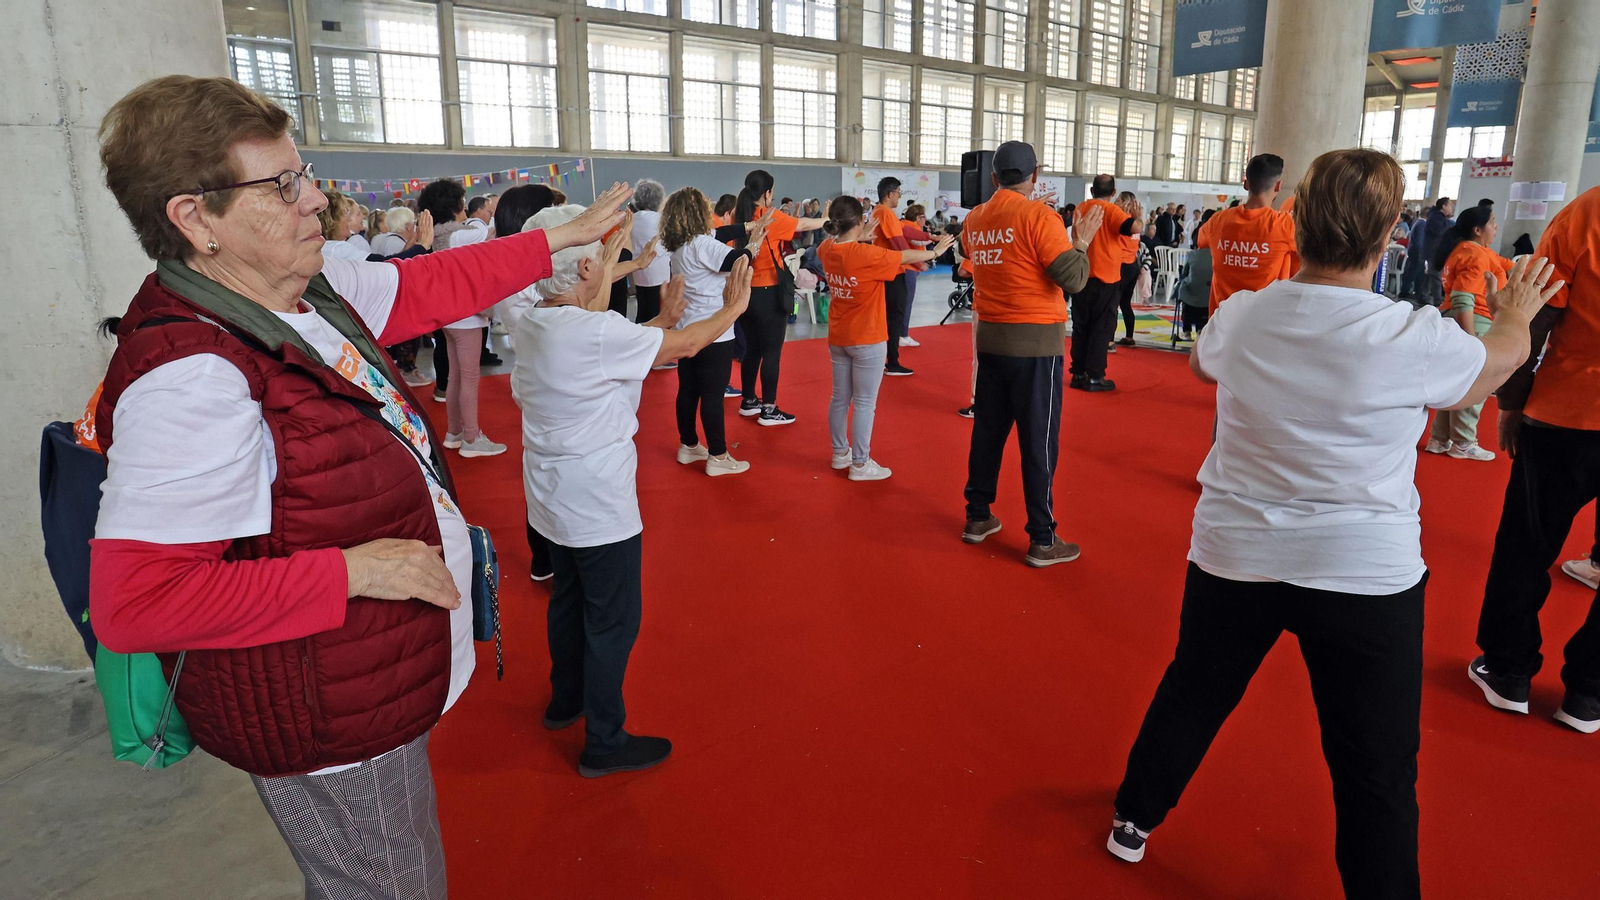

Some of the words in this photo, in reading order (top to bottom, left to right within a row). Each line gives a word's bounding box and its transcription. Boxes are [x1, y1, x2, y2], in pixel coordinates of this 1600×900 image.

[1428, 7, 1439, 15] de
[1442, 4, 1465, 14] Cádiz
[1217, 239, 1270, 254] AFANAS
[1223, 254, 1259, 268] JEREZ
[825, 271, 858, 288] FANAS
[830, 286, 854, 299] EREZ
